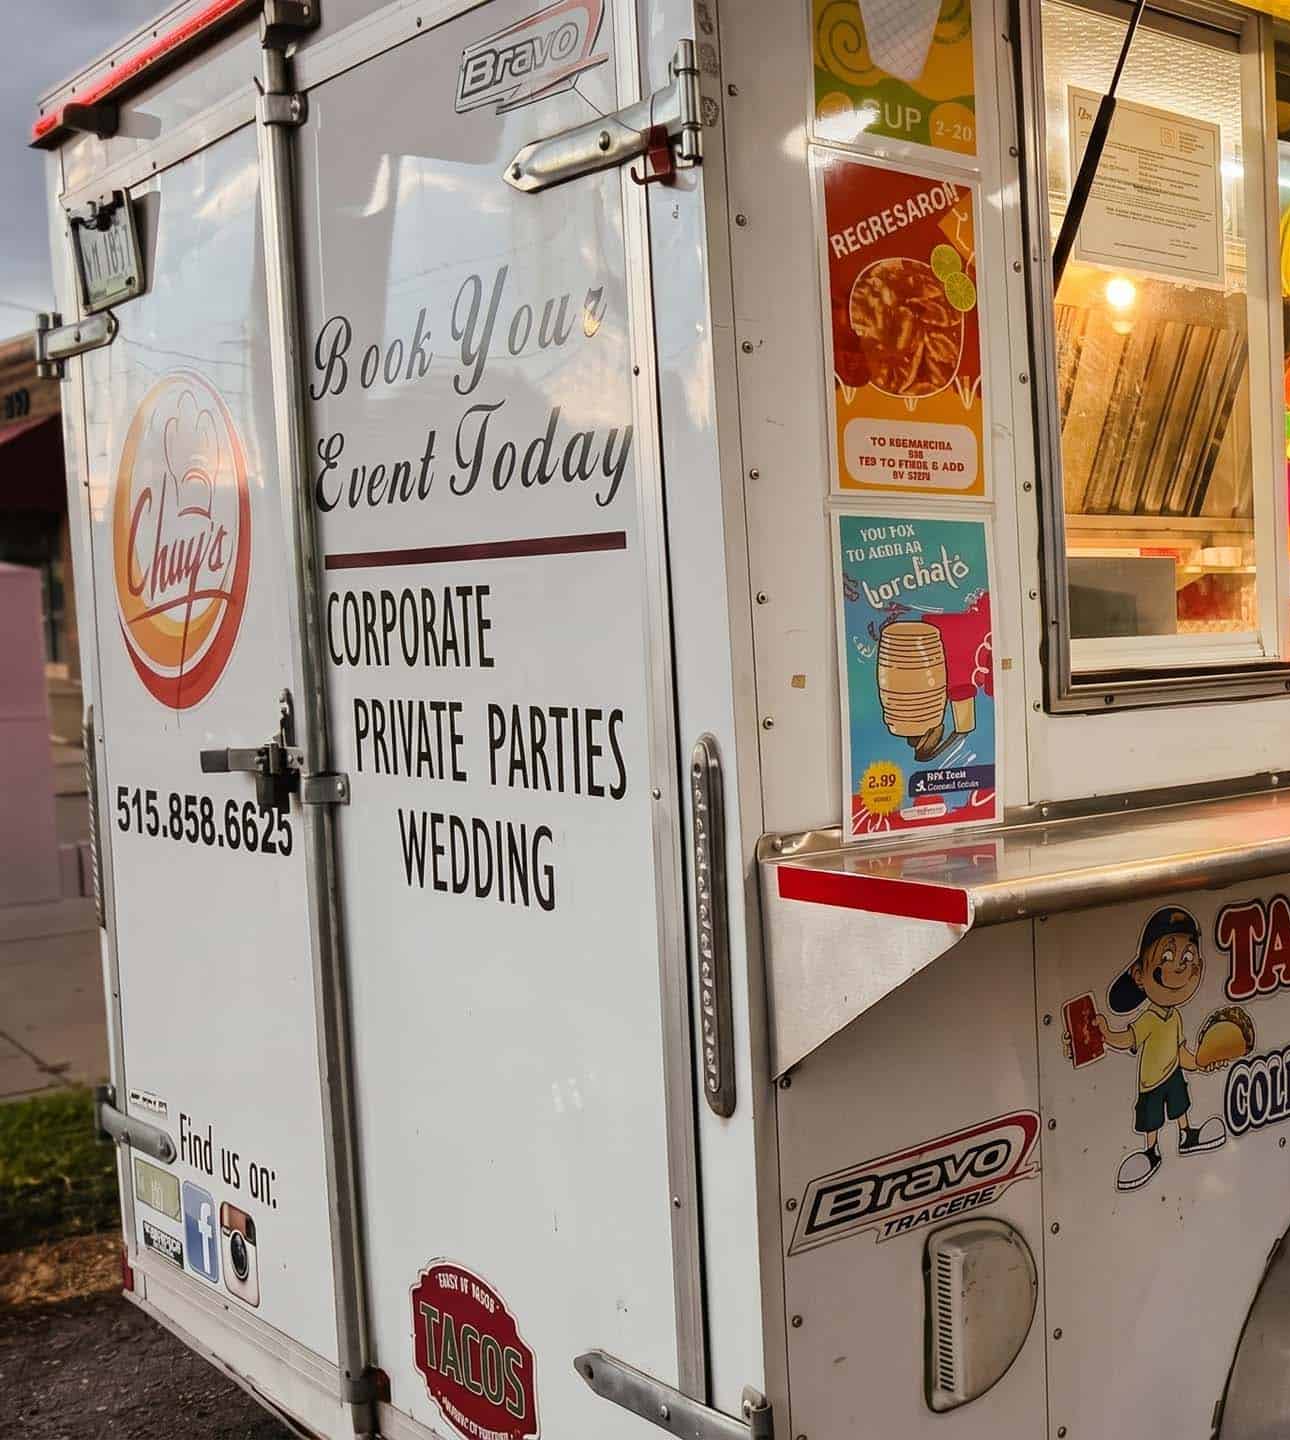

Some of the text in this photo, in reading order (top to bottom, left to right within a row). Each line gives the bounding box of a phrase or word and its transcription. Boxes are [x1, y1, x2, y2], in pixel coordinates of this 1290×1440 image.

[460, 21, 579, 99] Bravo
[309, 264, 608, 401] Book Your
[315, 399, 634, 513] Event Today
[127, 471, 228, 604] Chuy's
[327, 584, 495, 669] CORPORATE
[353, 697, 628, 801] PRIVATE PARTIES
[116, 785, 293, 857] 515.858.6625
[397, 808, 556, 912] WEDDING
[179, 1113, 278, 1209] Find us on:
[804, 1138, 1012, 1236] Bravo
[883, 1186, 996, 1237] TRACERE
[419, 1300, 526, 1420] TACOS
